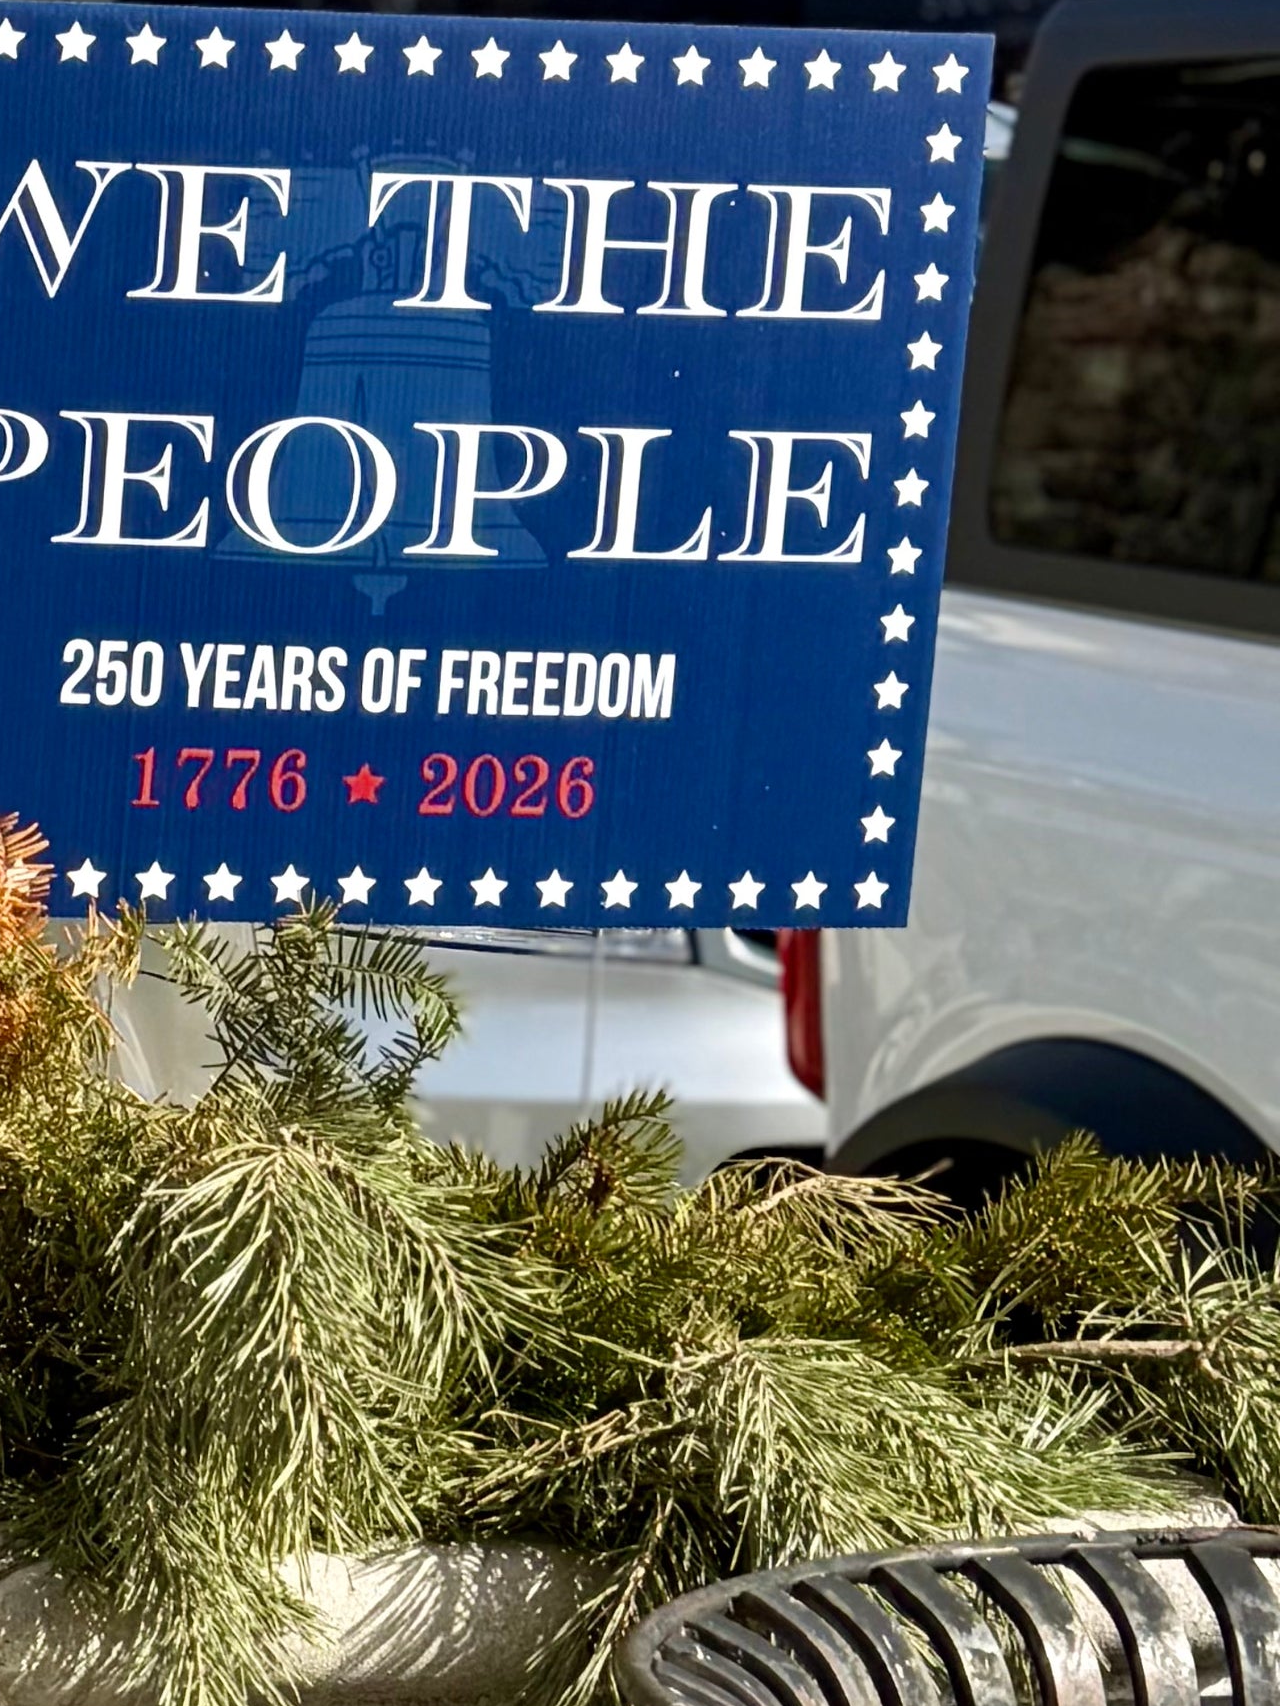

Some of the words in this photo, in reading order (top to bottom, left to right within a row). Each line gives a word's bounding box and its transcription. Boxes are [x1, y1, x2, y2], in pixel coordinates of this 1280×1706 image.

[369, 172, 892, 321] THE
[60, 640, 164, 707] 250
[179, 643, 345, 714] YEARS
[360, 650, 426, 715] OF
[437, 651, 676, 719] FREEDOM
[132, 749, 308, 811] 1776
[418, 755, 597, 818] 2026
